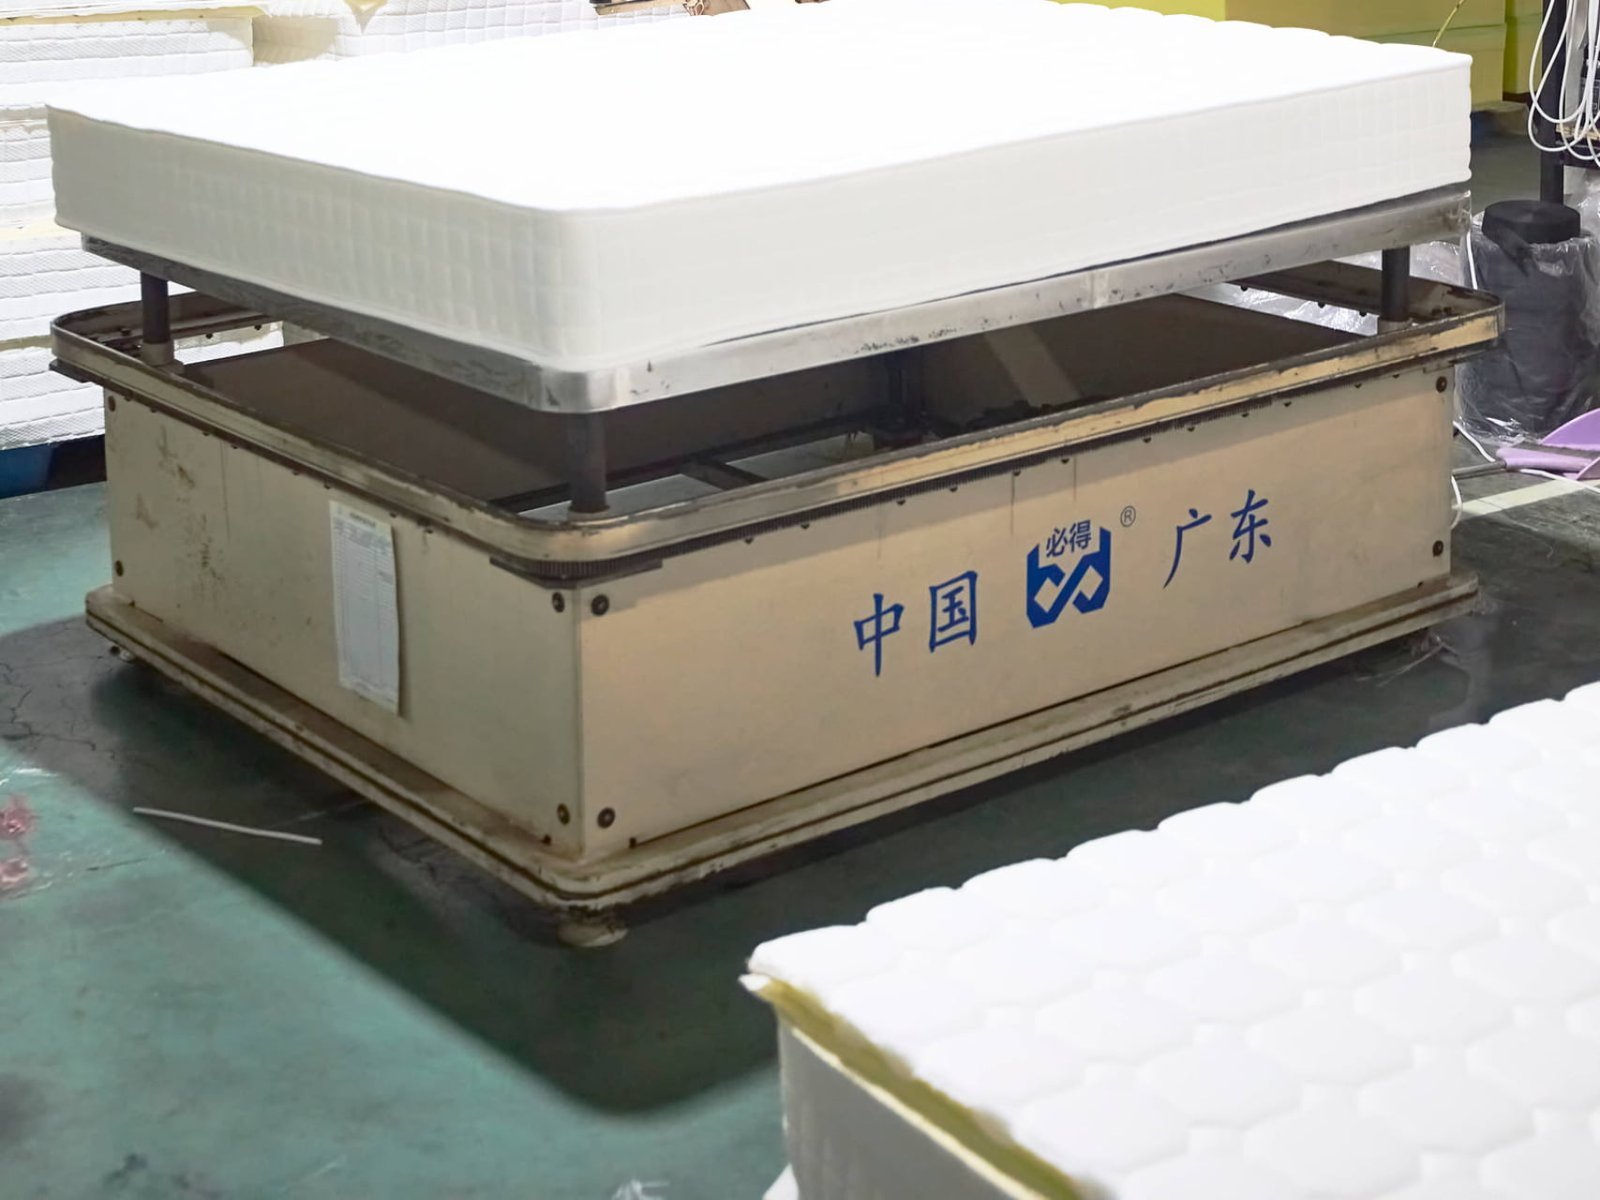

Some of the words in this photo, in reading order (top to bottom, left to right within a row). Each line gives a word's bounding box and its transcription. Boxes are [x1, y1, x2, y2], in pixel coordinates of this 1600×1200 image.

[854, 570, 979, 676] 中国
[1163, 489, 1272, 589] 广东
[1046, 519, 1092, 558] 必得
